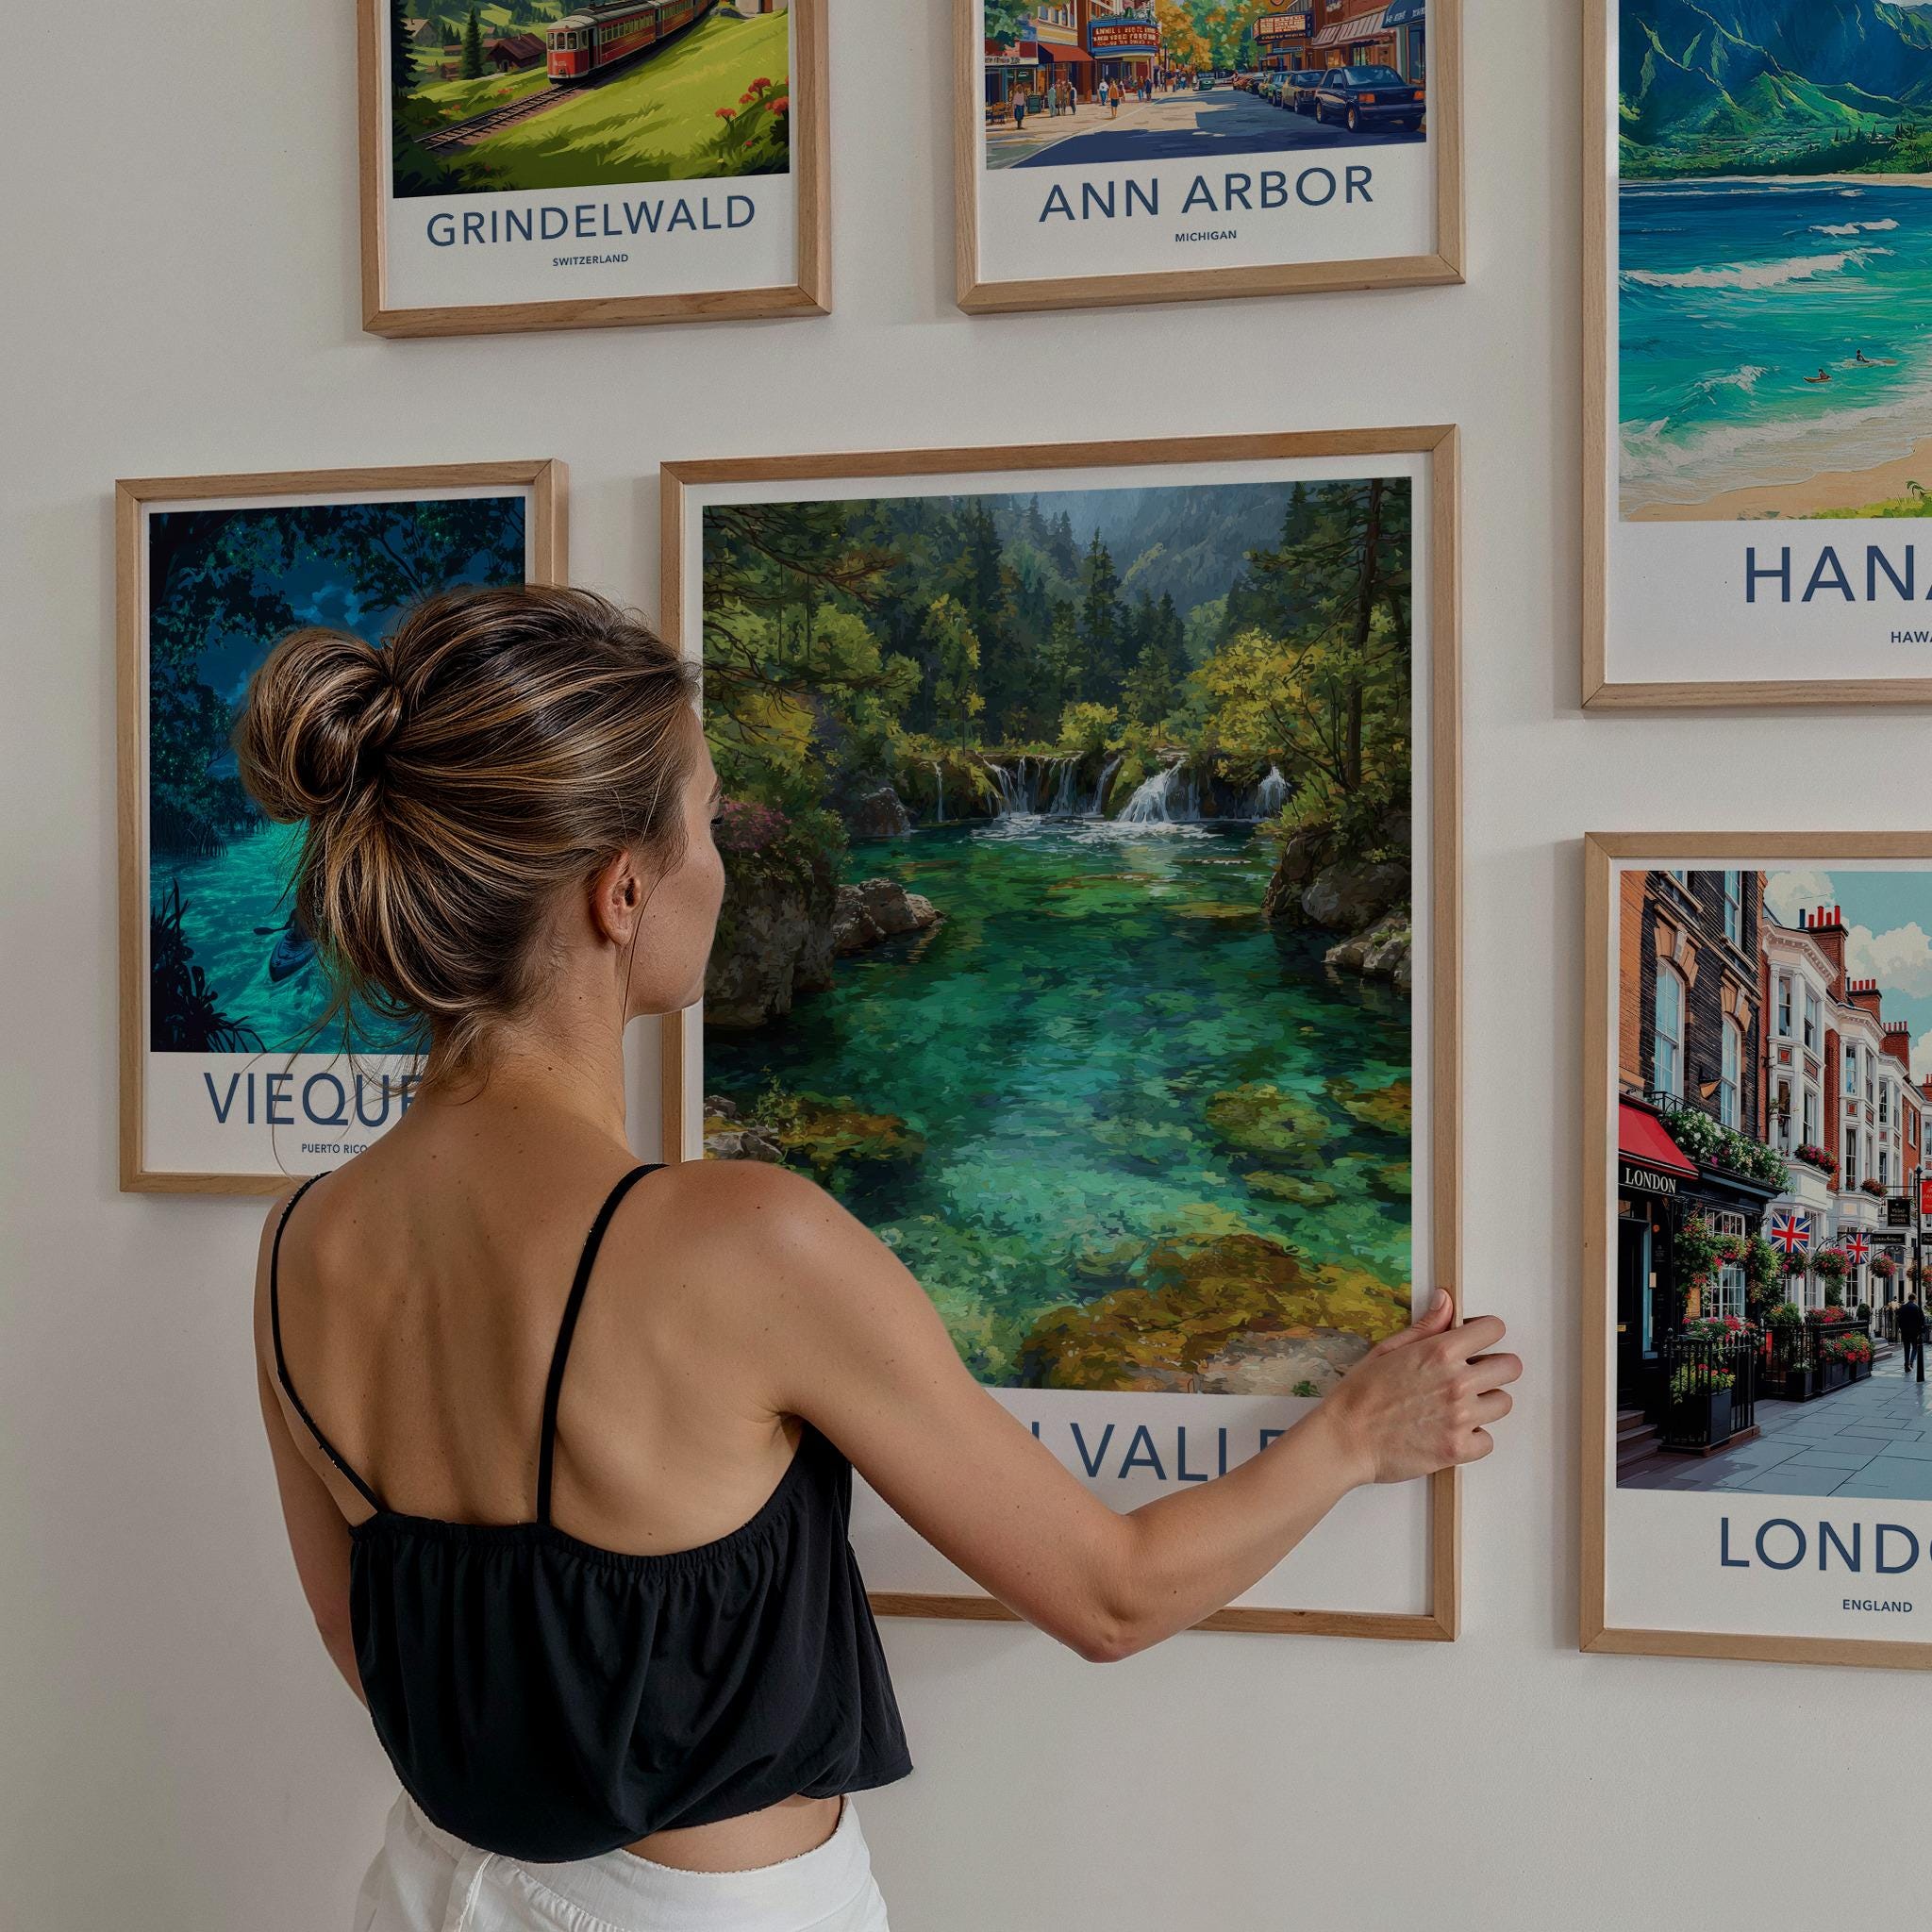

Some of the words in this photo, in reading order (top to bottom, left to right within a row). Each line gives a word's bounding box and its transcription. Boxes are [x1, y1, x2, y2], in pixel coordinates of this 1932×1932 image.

[1039, 177, 1159, 223] ANN
[1181, 165, 1374, 214] ARBOR
[426, 194, 756, 247] GRINDELWALD
[1174, 229, 1238, 242] MICHIGAN
[552, 253, 629, 268] SWITZERLAND
[1746, 544, 1932, 603] HAN
[301, 1142, 341, 1154] PUERTO
[343, 1143, 367, 1154] RICO
[1624, 1167, 1676, 1194] LONDON
[1721, 1517, 1932, 1574] LOND
[1842, 1598, 1913, 1613] ENGLAND
